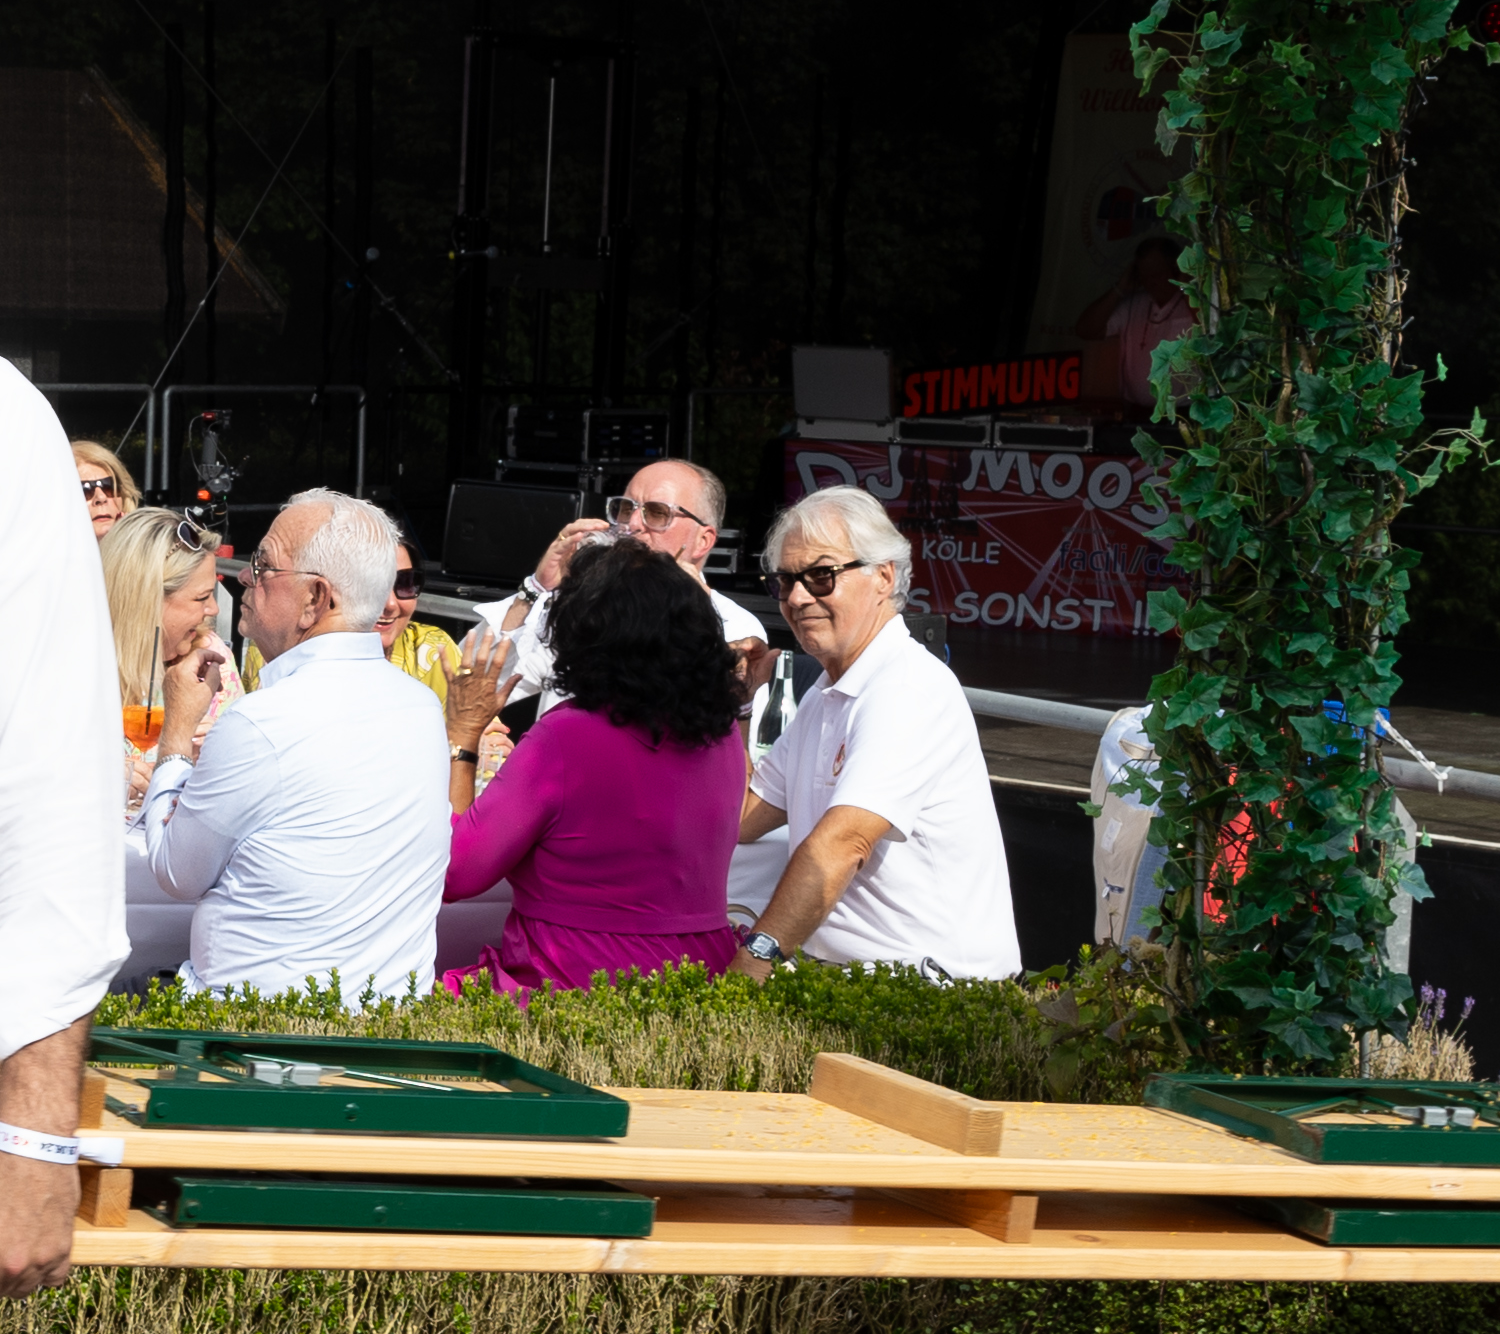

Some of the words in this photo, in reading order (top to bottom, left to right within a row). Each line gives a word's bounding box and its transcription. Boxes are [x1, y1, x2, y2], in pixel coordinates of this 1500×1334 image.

[902, 355, 1081, 418] STIMMUNG
[795, 445, 904, 501] DJ
[921, 535, 1002, 566] KÖLLE
[950, 591, 1115, 633] SONST
